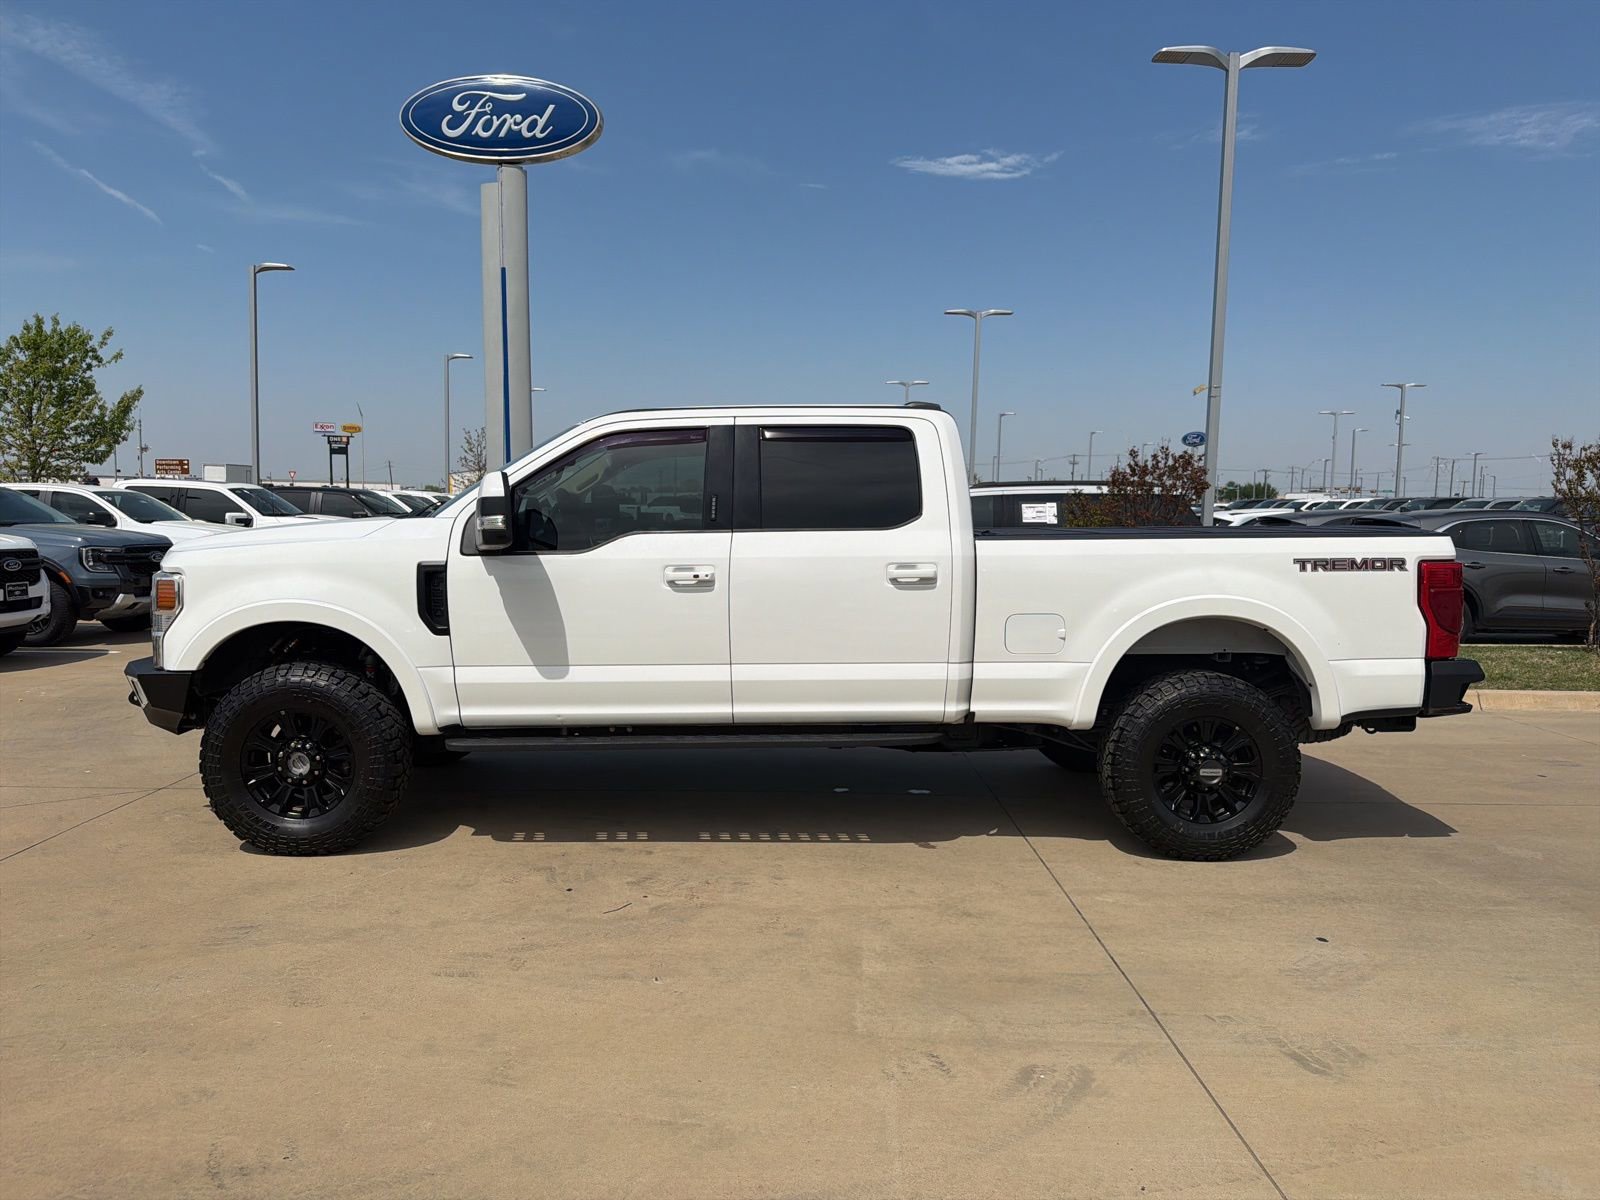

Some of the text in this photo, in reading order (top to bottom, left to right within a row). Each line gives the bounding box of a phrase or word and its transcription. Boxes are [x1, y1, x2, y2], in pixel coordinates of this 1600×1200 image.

[441, 90, 555, 138] Ford
[1186, 434, 1201, 444] Ford
[1293, 557, 1408, 572] TREMOR
